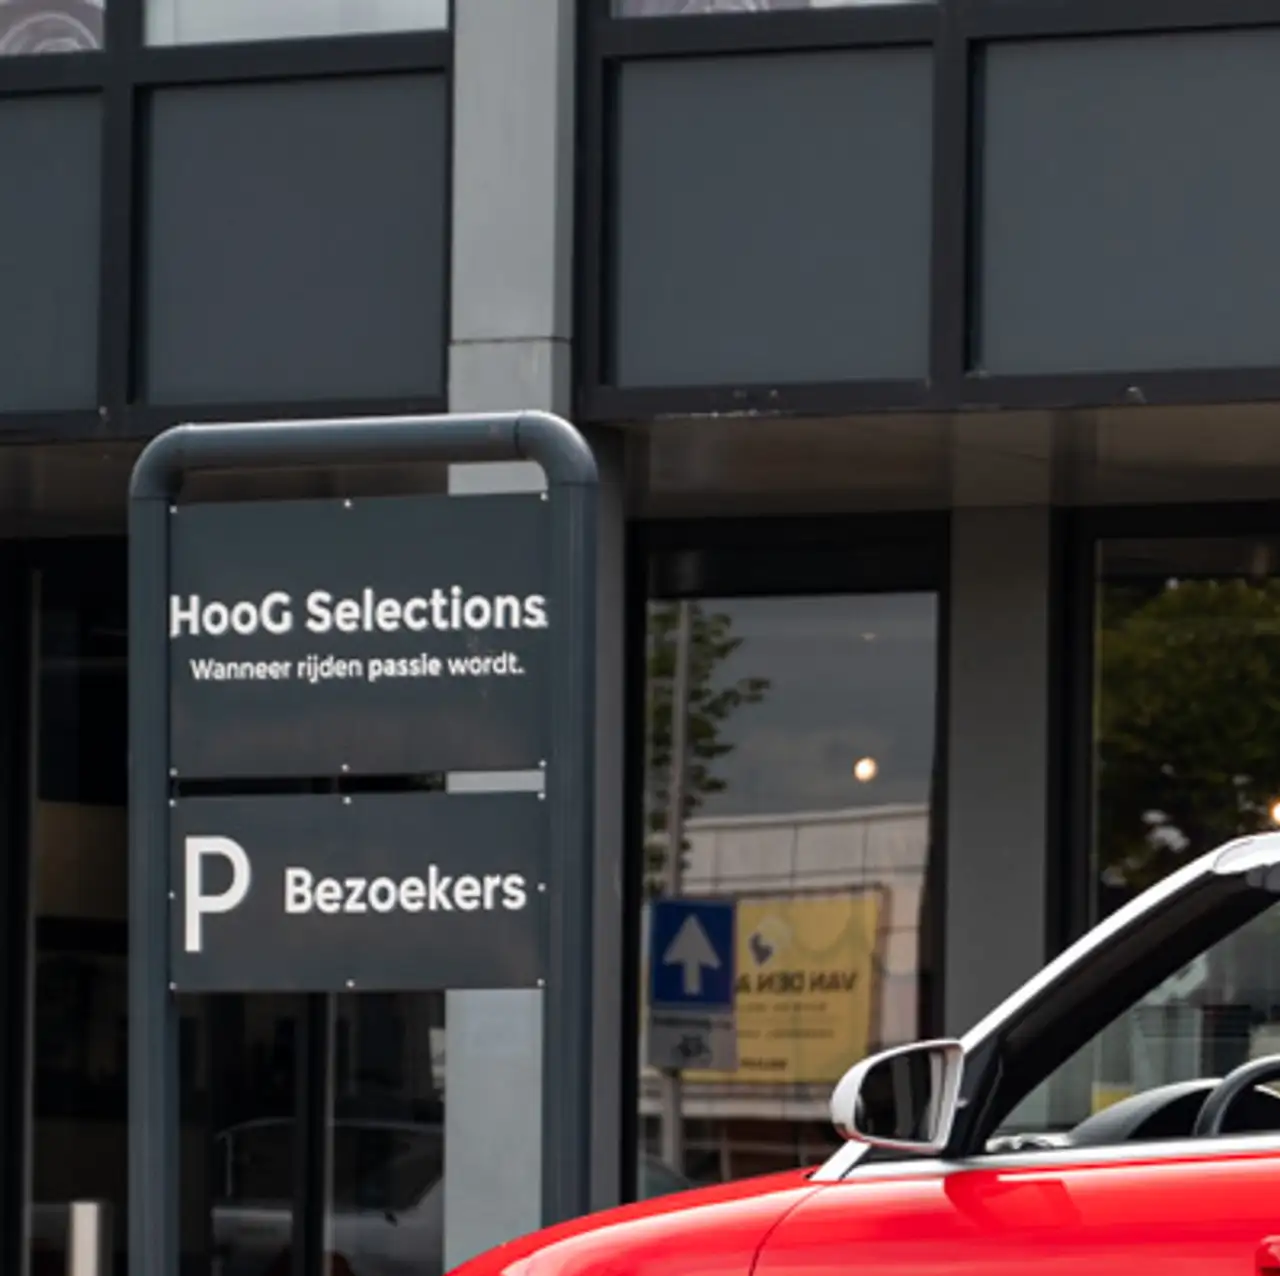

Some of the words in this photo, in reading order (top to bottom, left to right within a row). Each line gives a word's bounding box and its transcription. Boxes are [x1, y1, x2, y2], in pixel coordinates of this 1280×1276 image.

[169, 591, 293, 637] HooG
[305, 585, 548, 634] Selections
[189, 657, 292, 681] Wanneer
[297, 654, 363, 684] rijden
[367, 652, 442, 683] passie
[448, 651, 525, 675] wordt.
[185, 836, 250, 951] P
[285, 864, 527, 913] Bezoekers
